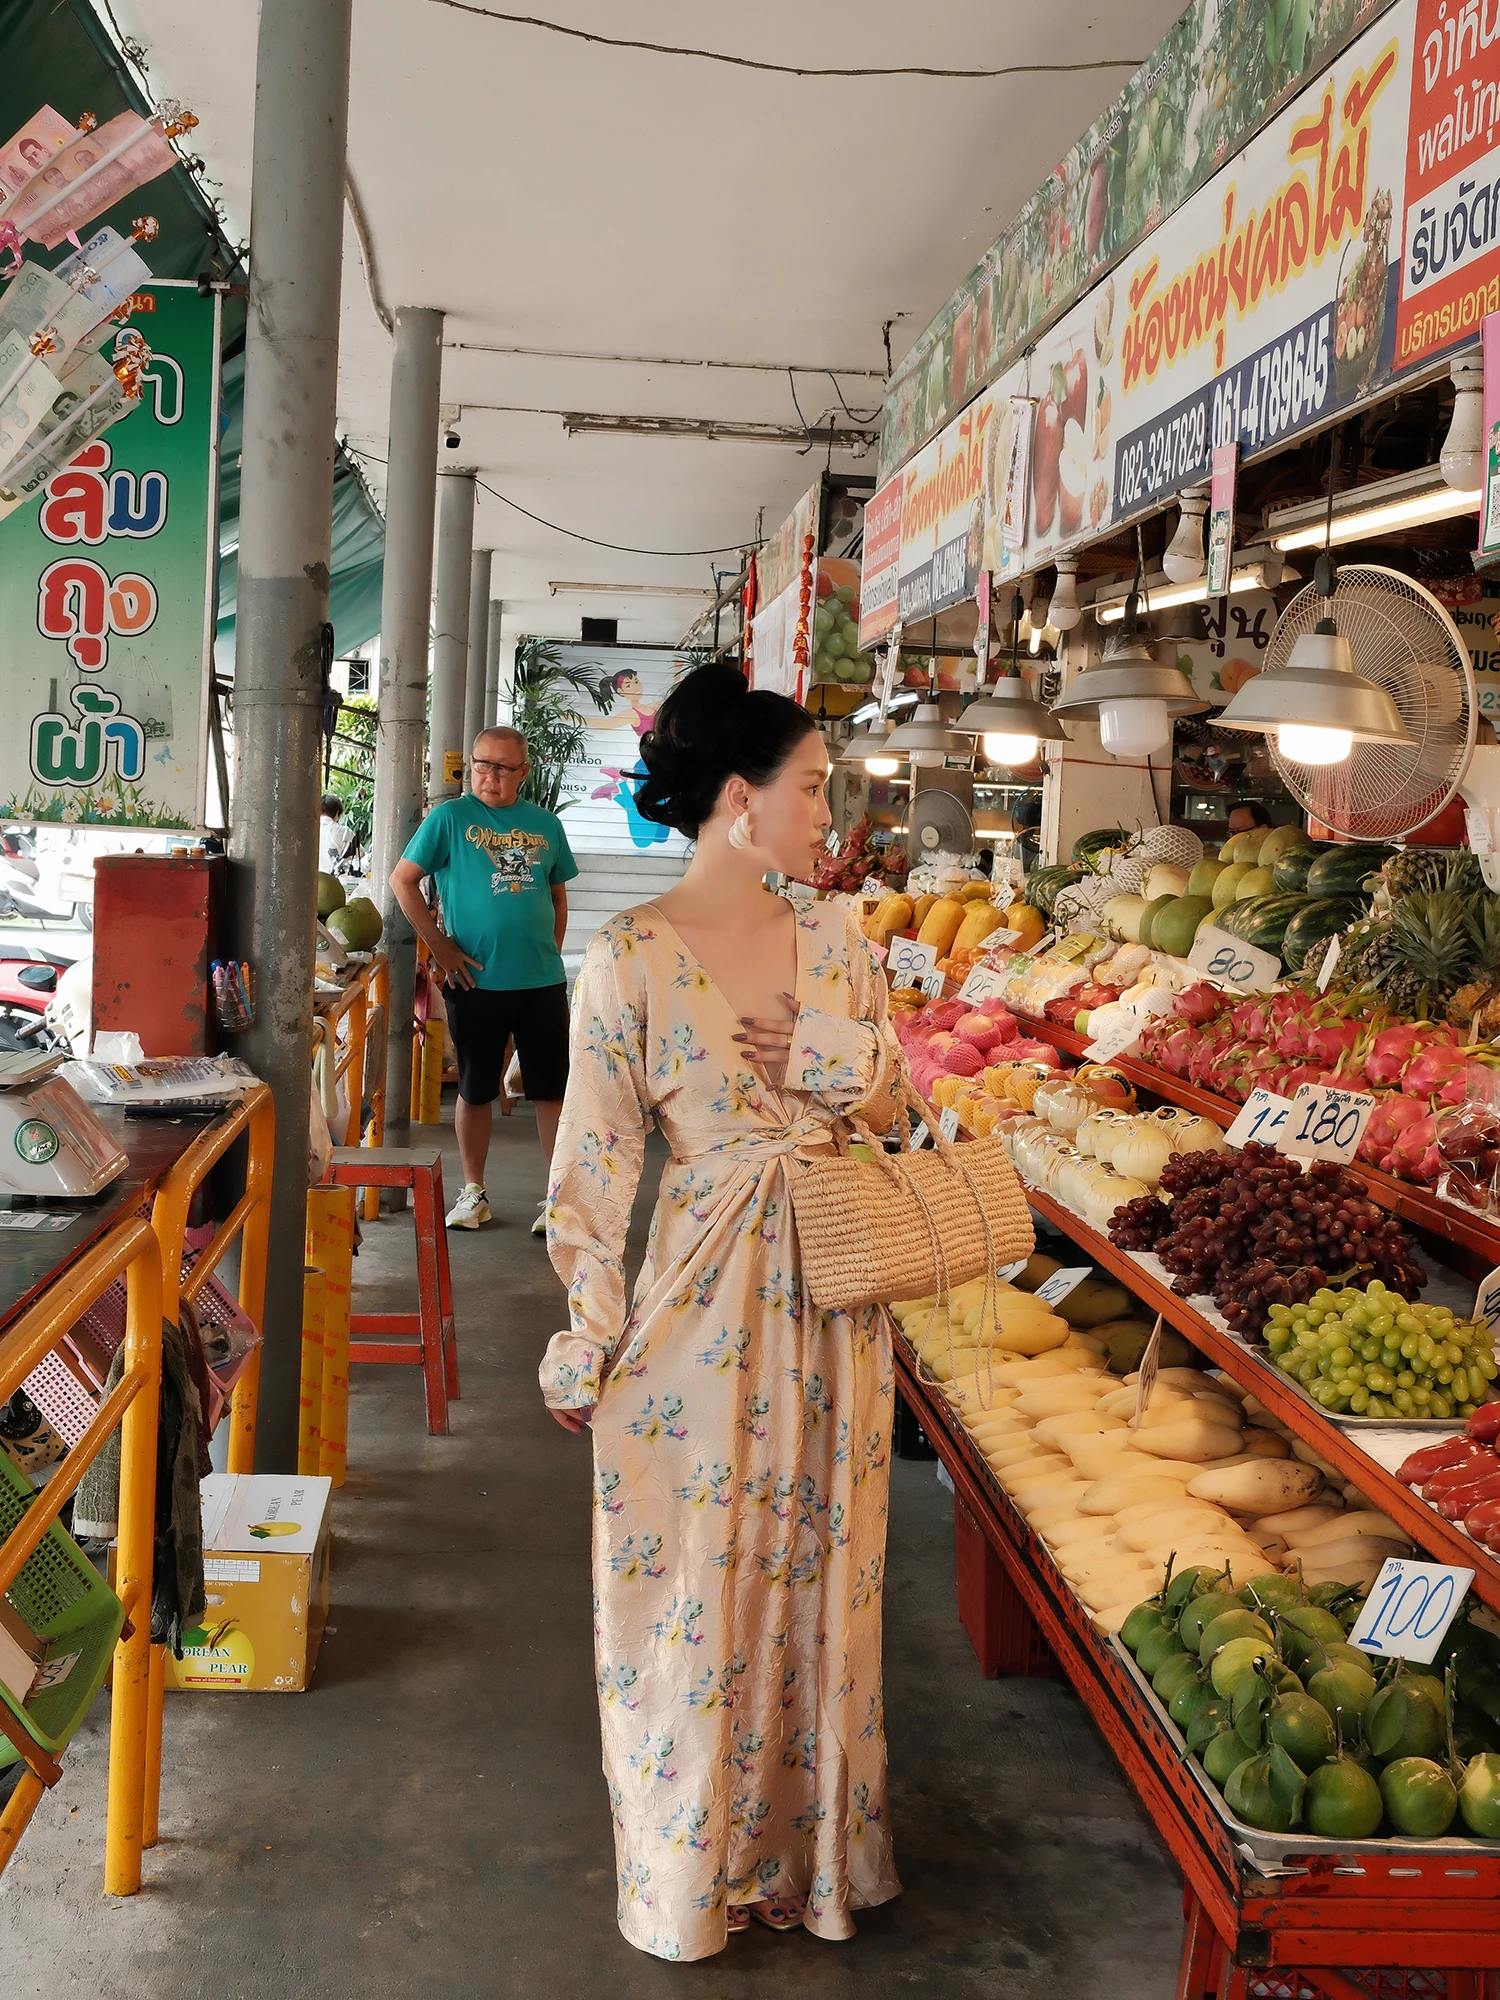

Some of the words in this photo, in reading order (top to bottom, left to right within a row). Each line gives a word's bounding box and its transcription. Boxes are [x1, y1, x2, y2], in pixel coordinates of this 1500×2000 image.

[1211, 312, 1330, 449] 061-4789645
[40, 560, 156, 670] ถุง
[33, 686, 144, 784] ผ้า
[465, 824, 512, 850] Wing
[511, 828, 549, 851] Ding
[863, 879, 878, 895] 80
[896, 947, 927, 972] 80
[1207, 947, 1255, 982] 80
[966, 973, 996, 1004] 25
[1296, 1099, 1360, 1148] 180
[264, 1497, 282, 1520] KOREAN
[291, 1489, 305, 1506] PEAR
[1358, 1573, 1455, 1650] 100
[173, 1646, 232, 1658] OREAN
[209, 1663, 249, 1674] PEAR
